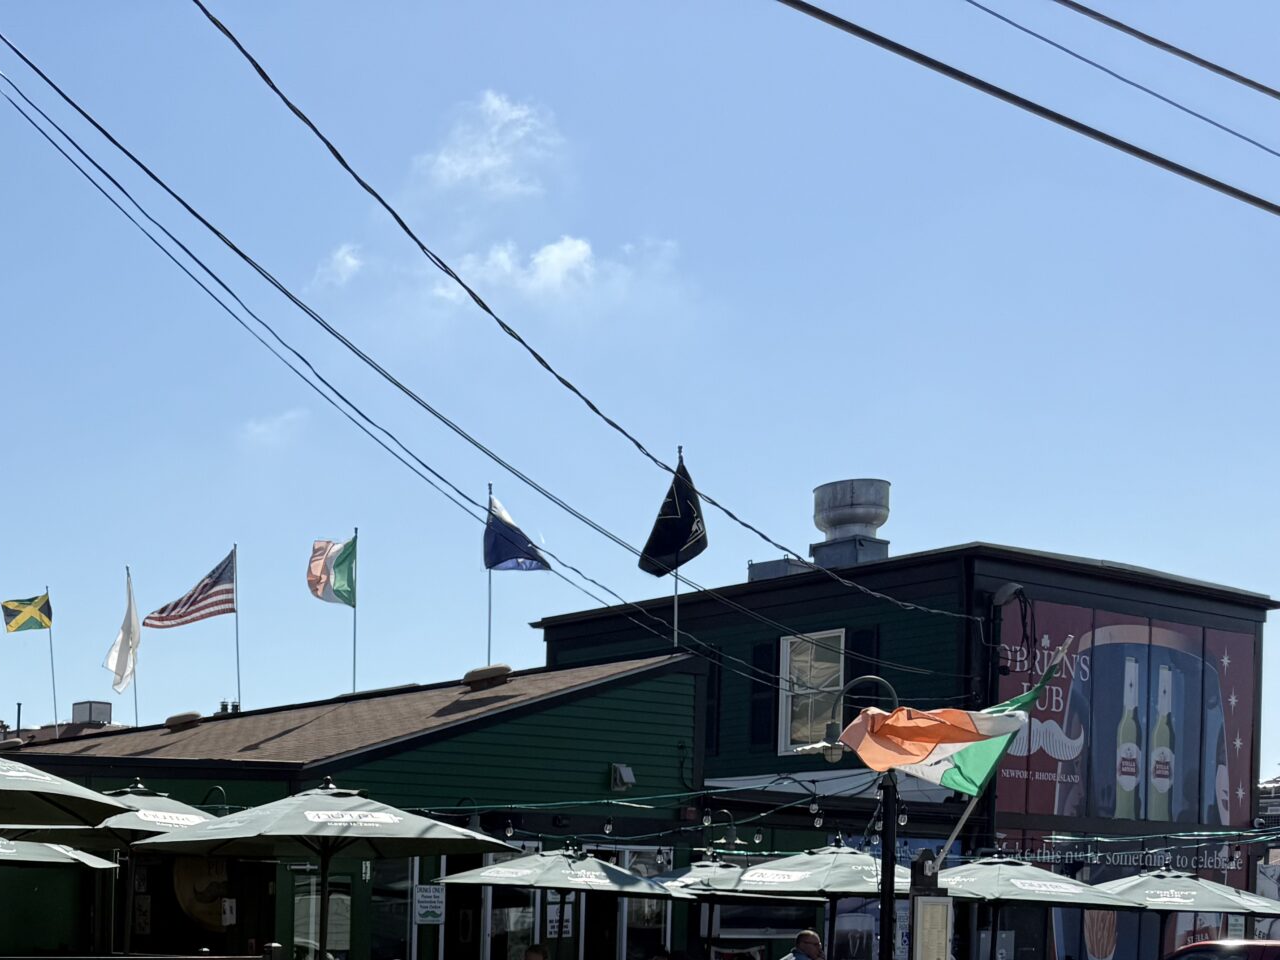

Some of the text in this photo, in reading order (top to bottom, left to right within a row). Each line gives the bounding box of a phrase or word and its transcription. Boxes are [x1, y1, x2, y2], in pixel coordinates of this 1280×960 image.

[1058, 772, 1080, 783] SLAND
[1176, 854, 1188, 869] to
[1191, 850, 1243, 870] celebrte
